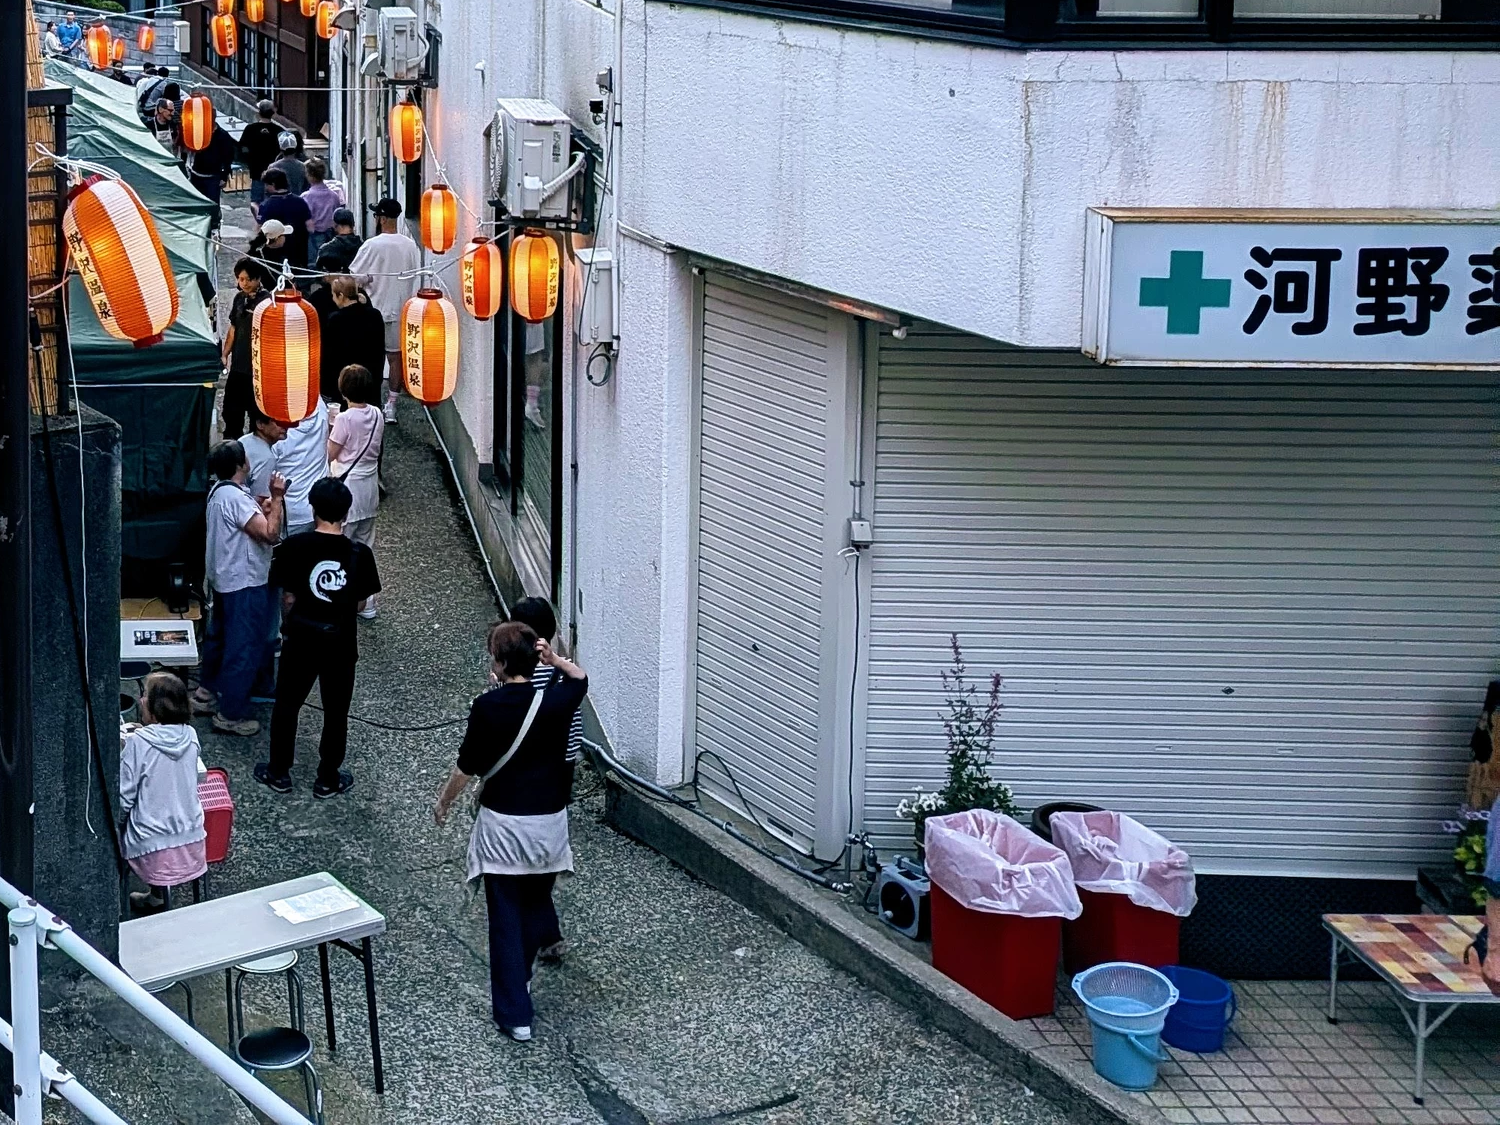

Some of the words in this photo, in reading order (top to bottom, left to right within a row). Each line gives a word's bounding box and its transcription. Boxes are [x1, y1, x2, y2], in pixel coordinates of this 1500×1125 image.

[67, 230, 113, 320] 野沢温泉
[407, 322, 422, 388] 野沢温泉
